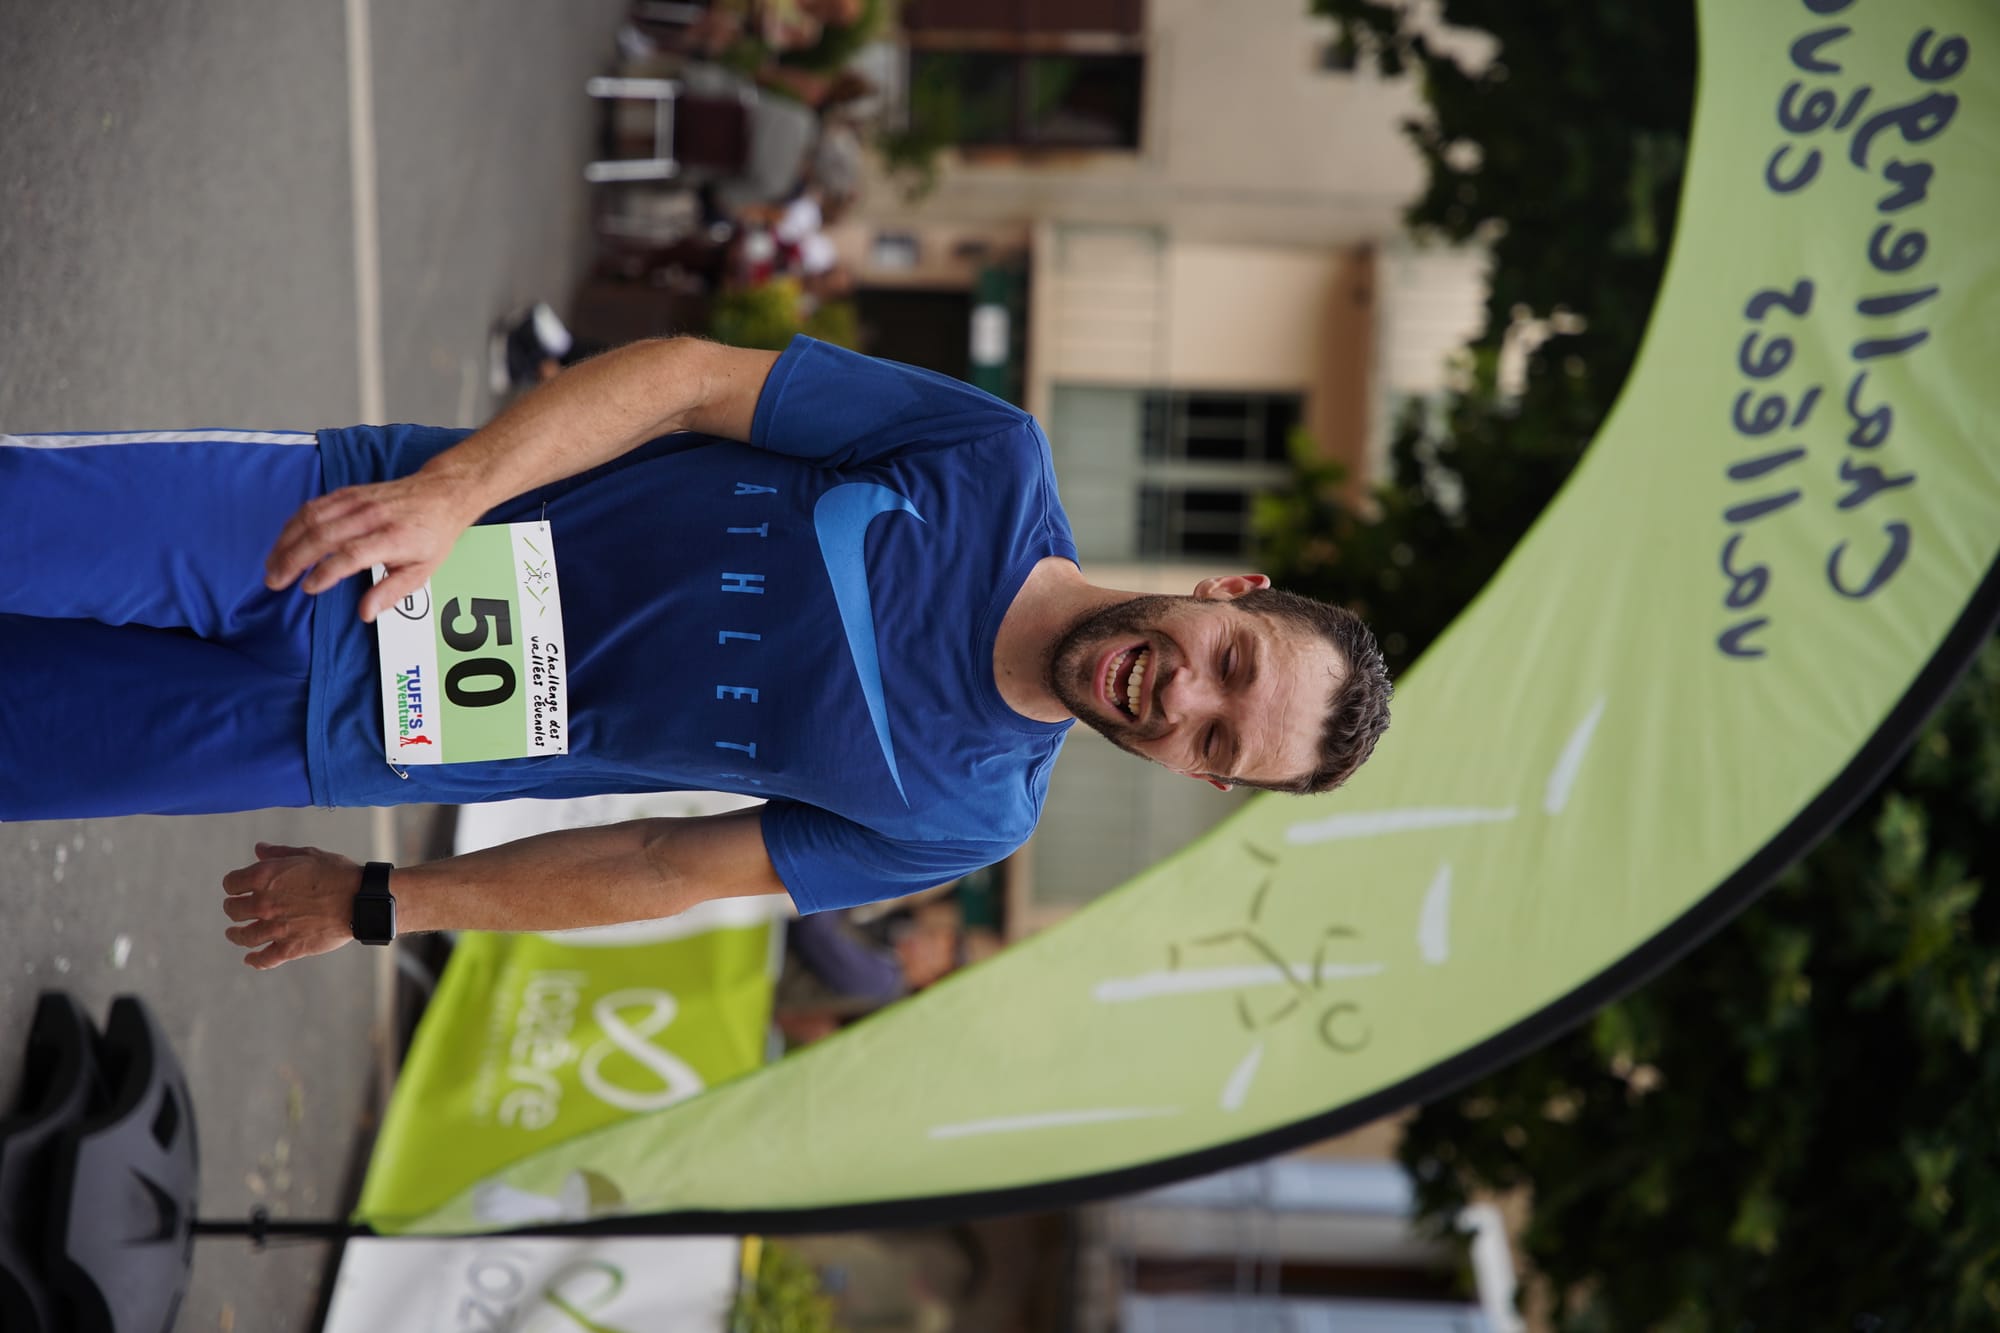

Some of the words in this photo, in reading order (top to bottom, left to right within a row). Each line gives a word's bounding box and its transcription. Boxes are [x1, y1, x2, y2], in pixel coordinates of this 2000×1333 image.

[440, 597, 517, 708] 50
[530, 636, 547, 687] vallées
[545, 643, 560, 713] Challenge
[397, 673, 410, 737] Aventure
[406, 665, 423, 729] TUFF'S
[533, 695, 546, 748] cévenoles
[549, 720, 561, 740] des
